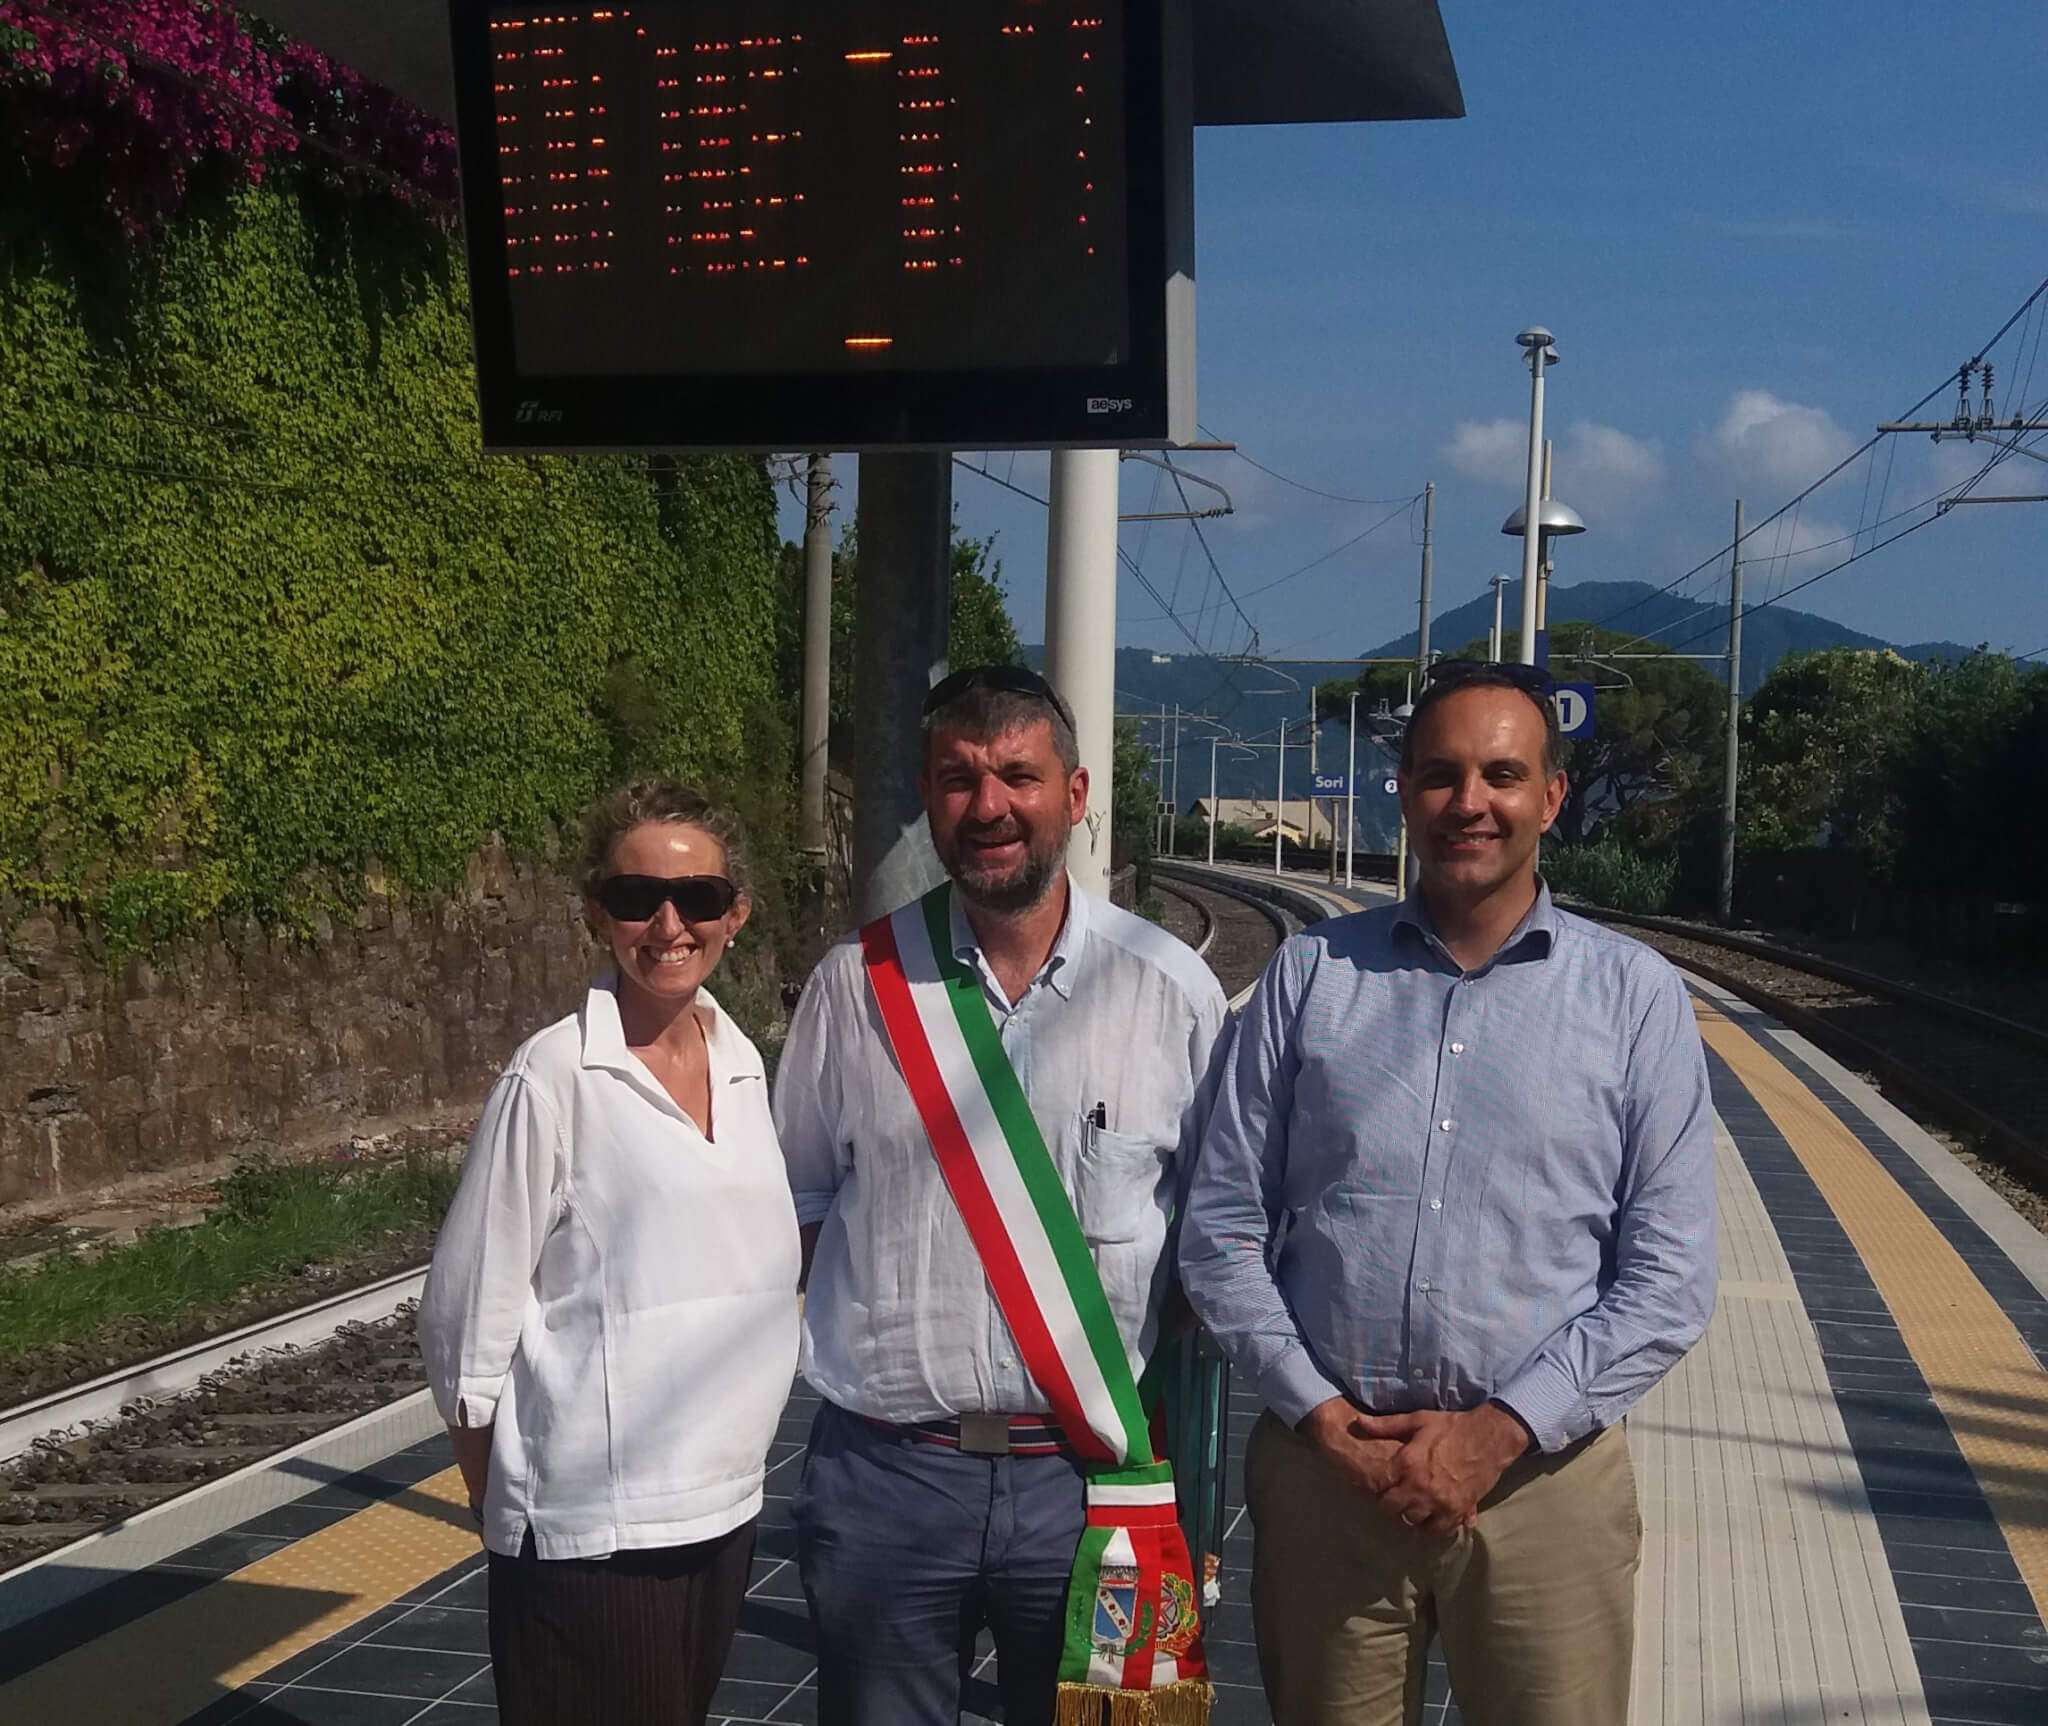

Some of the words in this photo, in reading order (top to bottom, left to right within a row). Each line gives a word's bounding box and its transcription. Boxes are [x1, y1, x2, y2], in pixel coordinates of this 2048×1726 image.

[1090, 398, 1132, 413] aesys
[1559, 697, 1571, 724] 1
[1315, 775, 1343, 788] Sori
